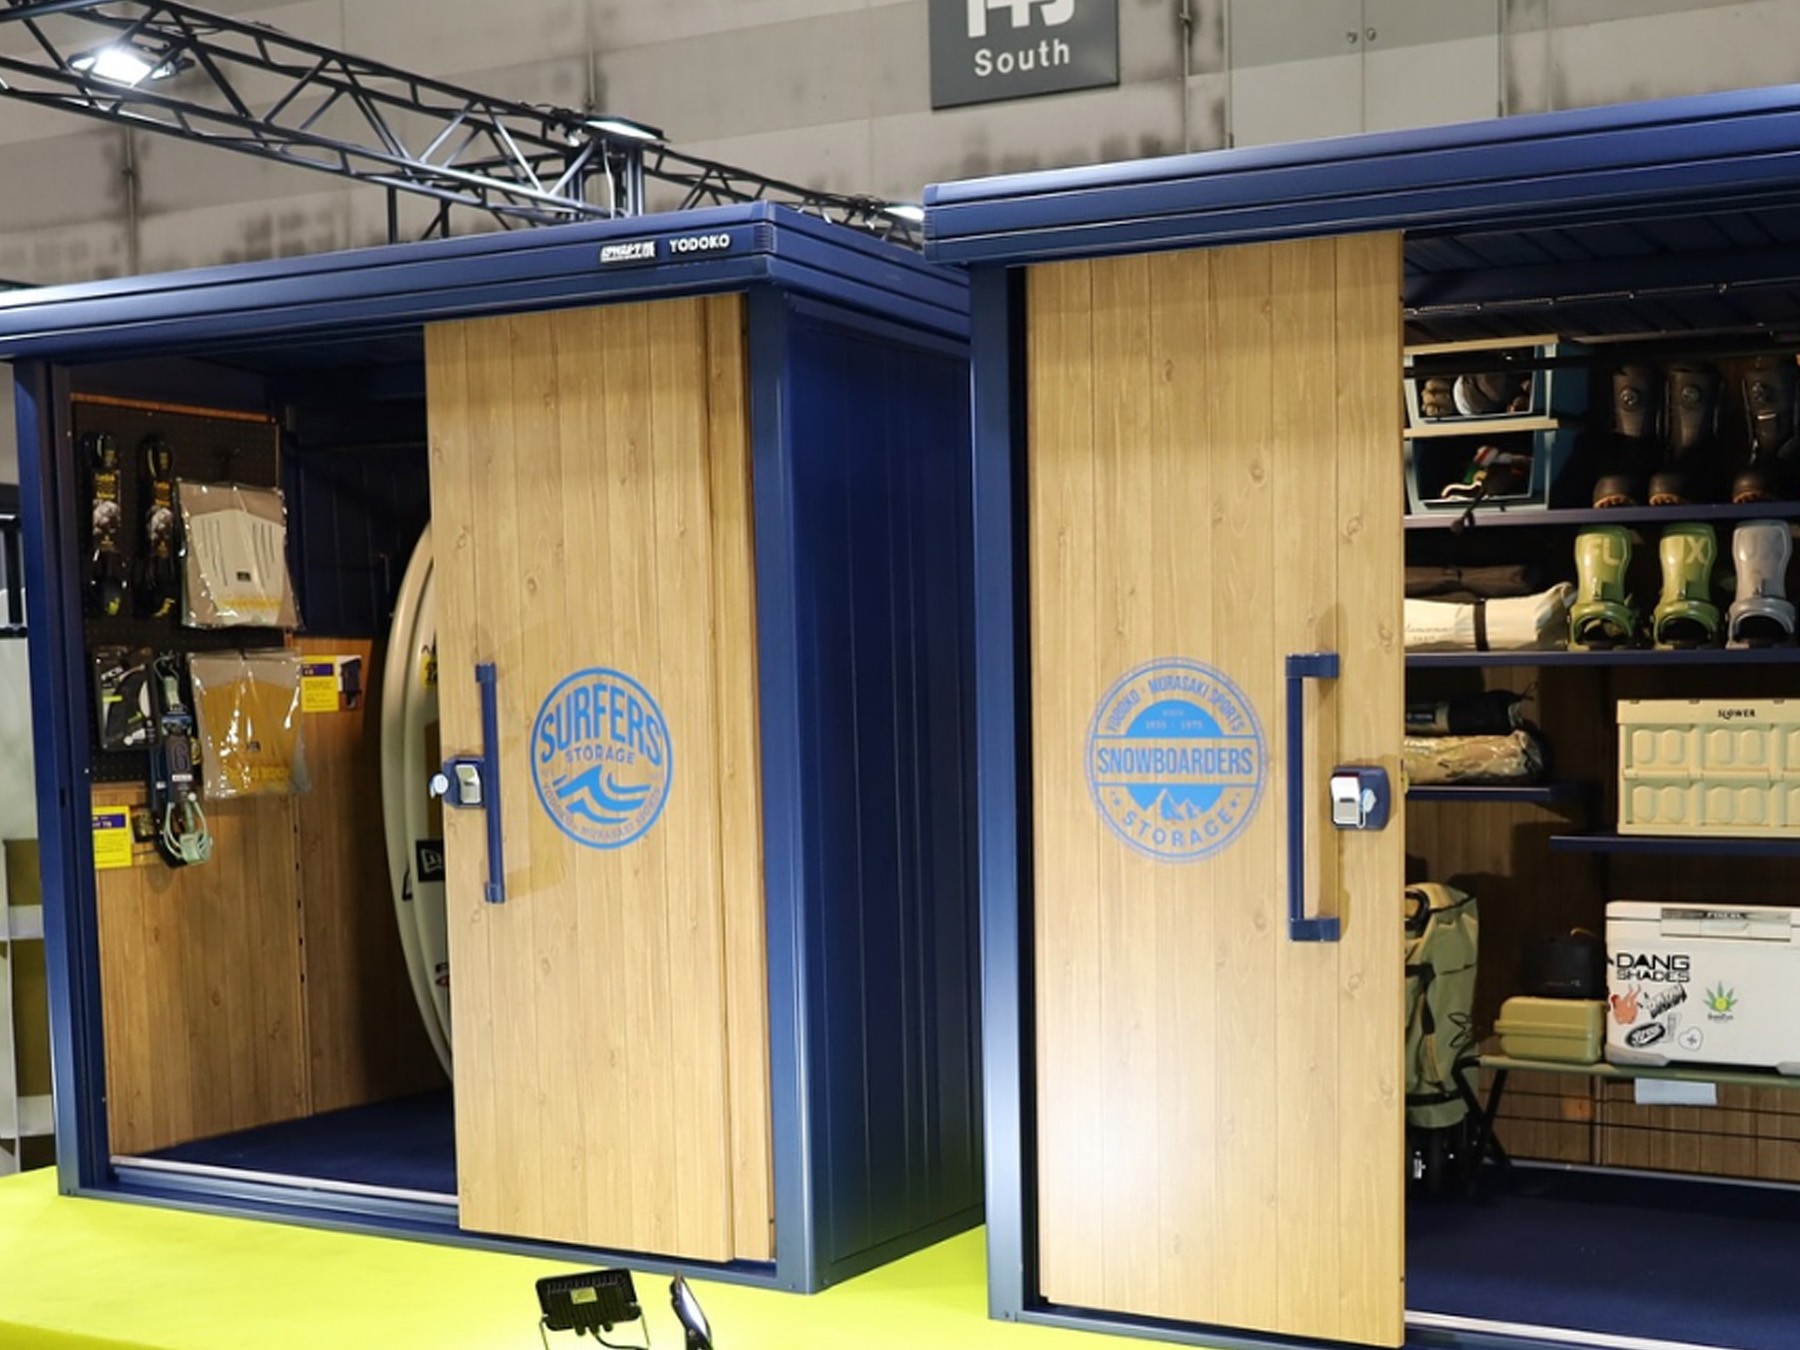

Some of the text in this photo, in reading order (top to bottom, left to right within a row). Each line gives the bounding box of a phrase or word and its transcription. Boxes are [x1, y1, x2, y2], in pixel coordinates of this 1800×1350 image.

[974, 38, 1070, 77] South
[669, 233, 731, 253] YODOKO
[1148, 675, 1209, 698] MURASAKI
[1209, 688, 1246, 733] SPORTS
[1717, 708, 1756, 720] SLOWER
[540, 682, 662, 766] SURFERS
[565, 745, 635, 764] STORAGE
[1097, 747, 1253, 775] SNOWBOARDERS
[1123, 807, 1234, 847] STORAGE
[1616, 953, 1690, 970] DANG
[1616, 970, 1690, 983] SHADES
